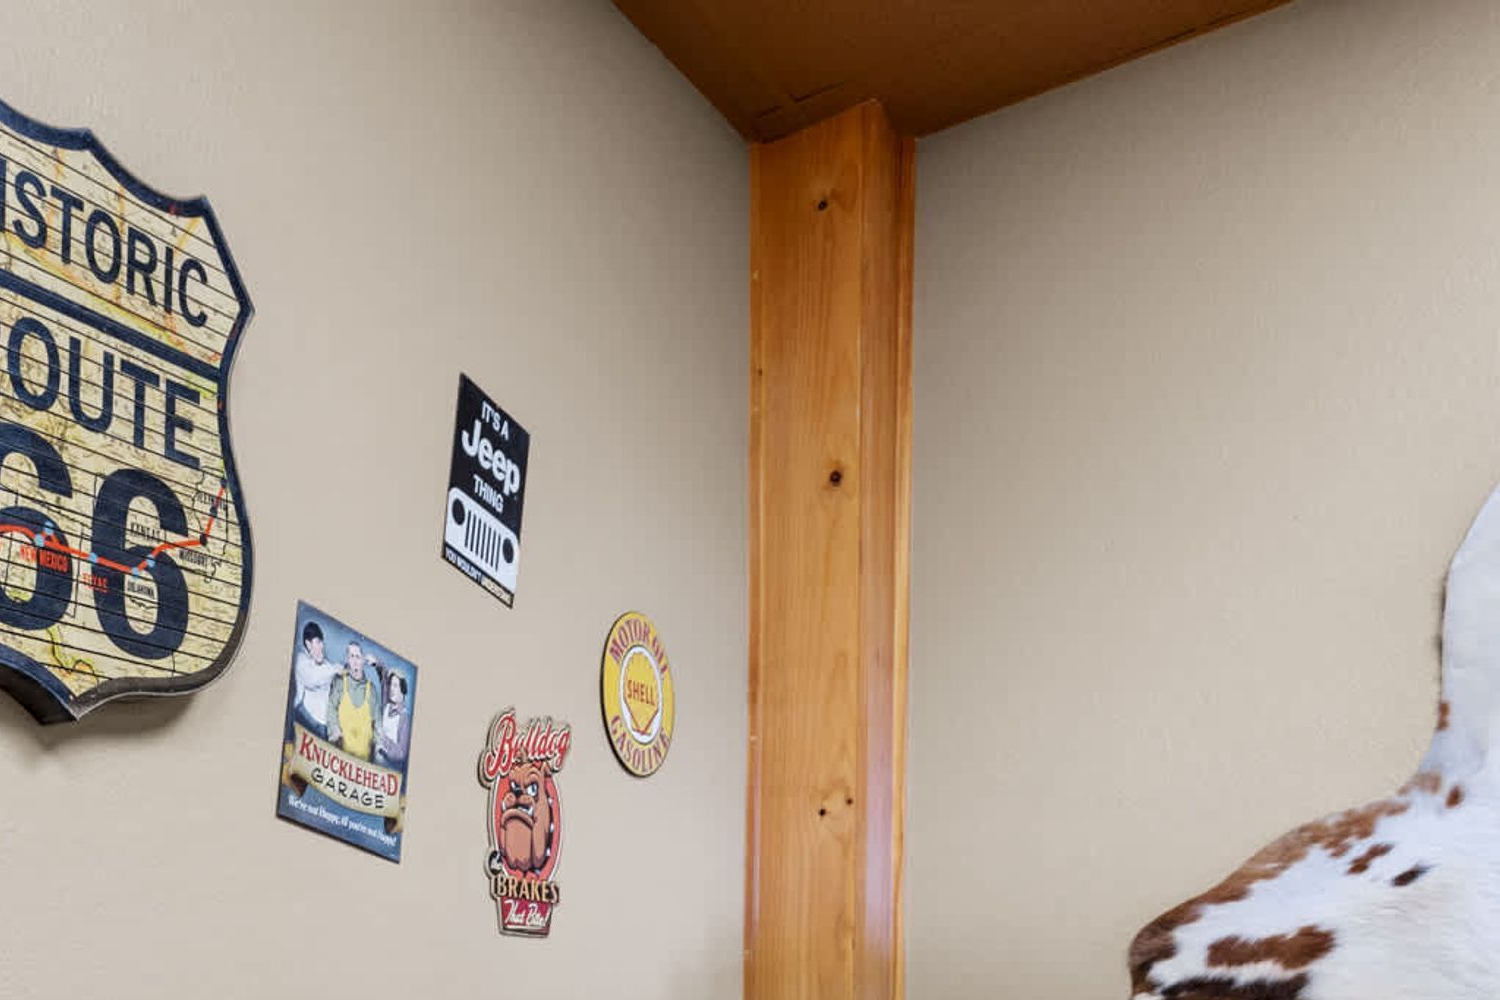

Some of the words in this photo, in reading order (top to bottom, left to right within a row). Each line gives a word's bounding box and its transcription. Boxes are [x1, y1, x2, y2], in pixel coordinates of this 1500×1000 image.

[481, 401, 500, 430] IT'S
[501, 420, 509, 440] A
[462, 419, 520, 495] Jeep
[473, 474, 503, 512] THING
[609, 618, 650, 664] MOTOR
[627, 679, 655, 706] SHELL
[299, 732, 398, 796] KNUCKLEHEAD
[486, 713, 570, 778] Bulldog
[611, 715, 670, 772] GASOLINE
[311, 767, 384, 808] GARAGE
[496, 873, 558, 903] BRAKES
